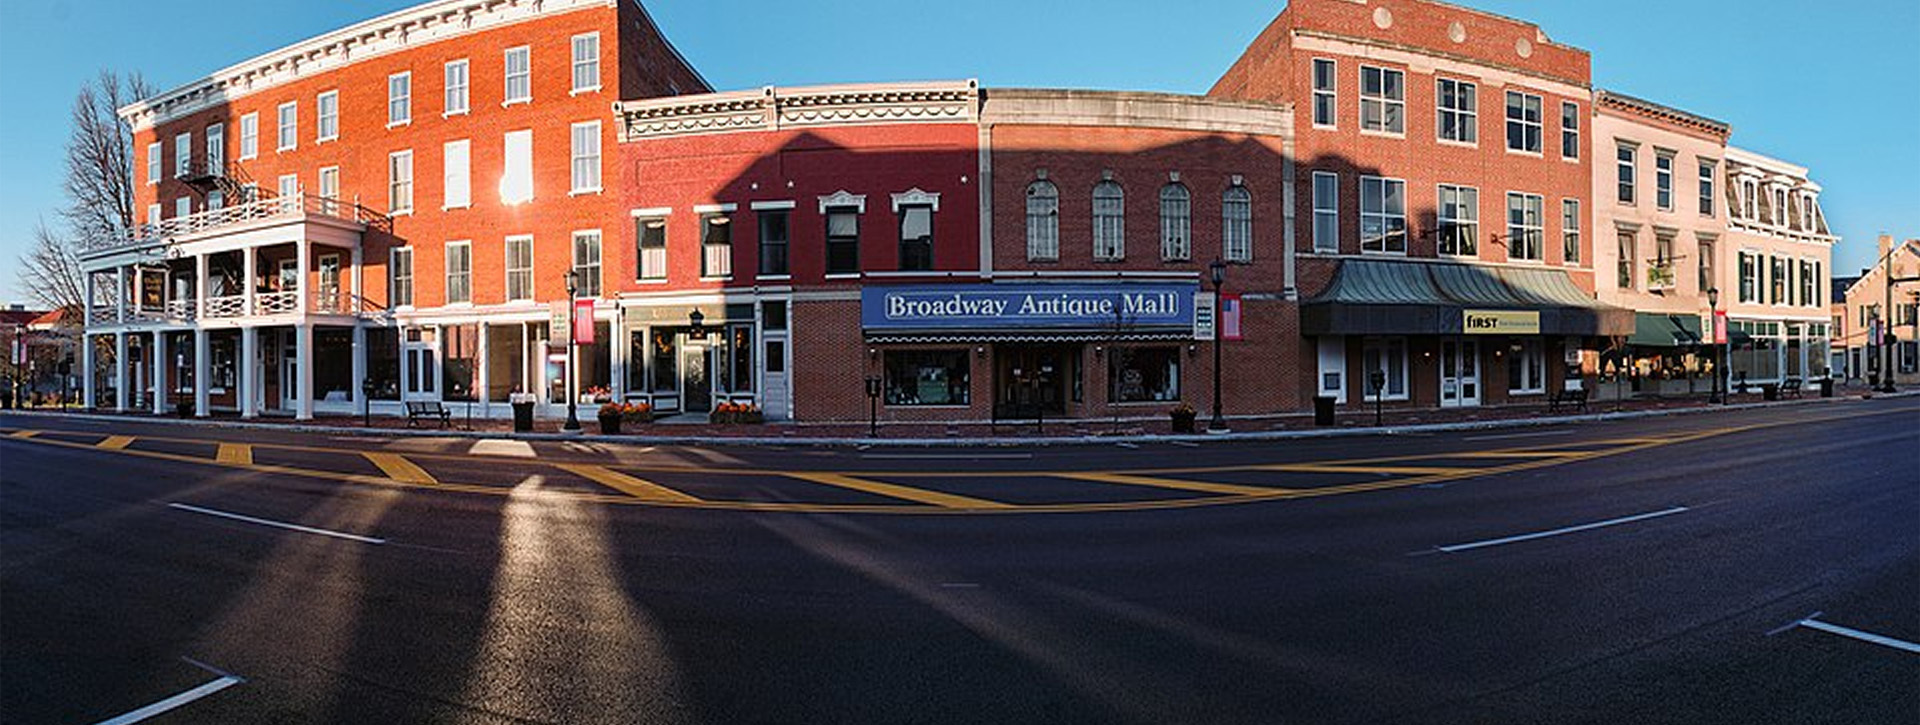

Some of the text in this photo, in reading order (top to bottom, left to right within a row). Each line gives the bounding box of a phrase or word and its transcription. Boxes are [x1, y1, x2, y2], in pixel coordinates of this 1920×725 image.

[889, 294, 1175, 316] Broadway Antique Mall
